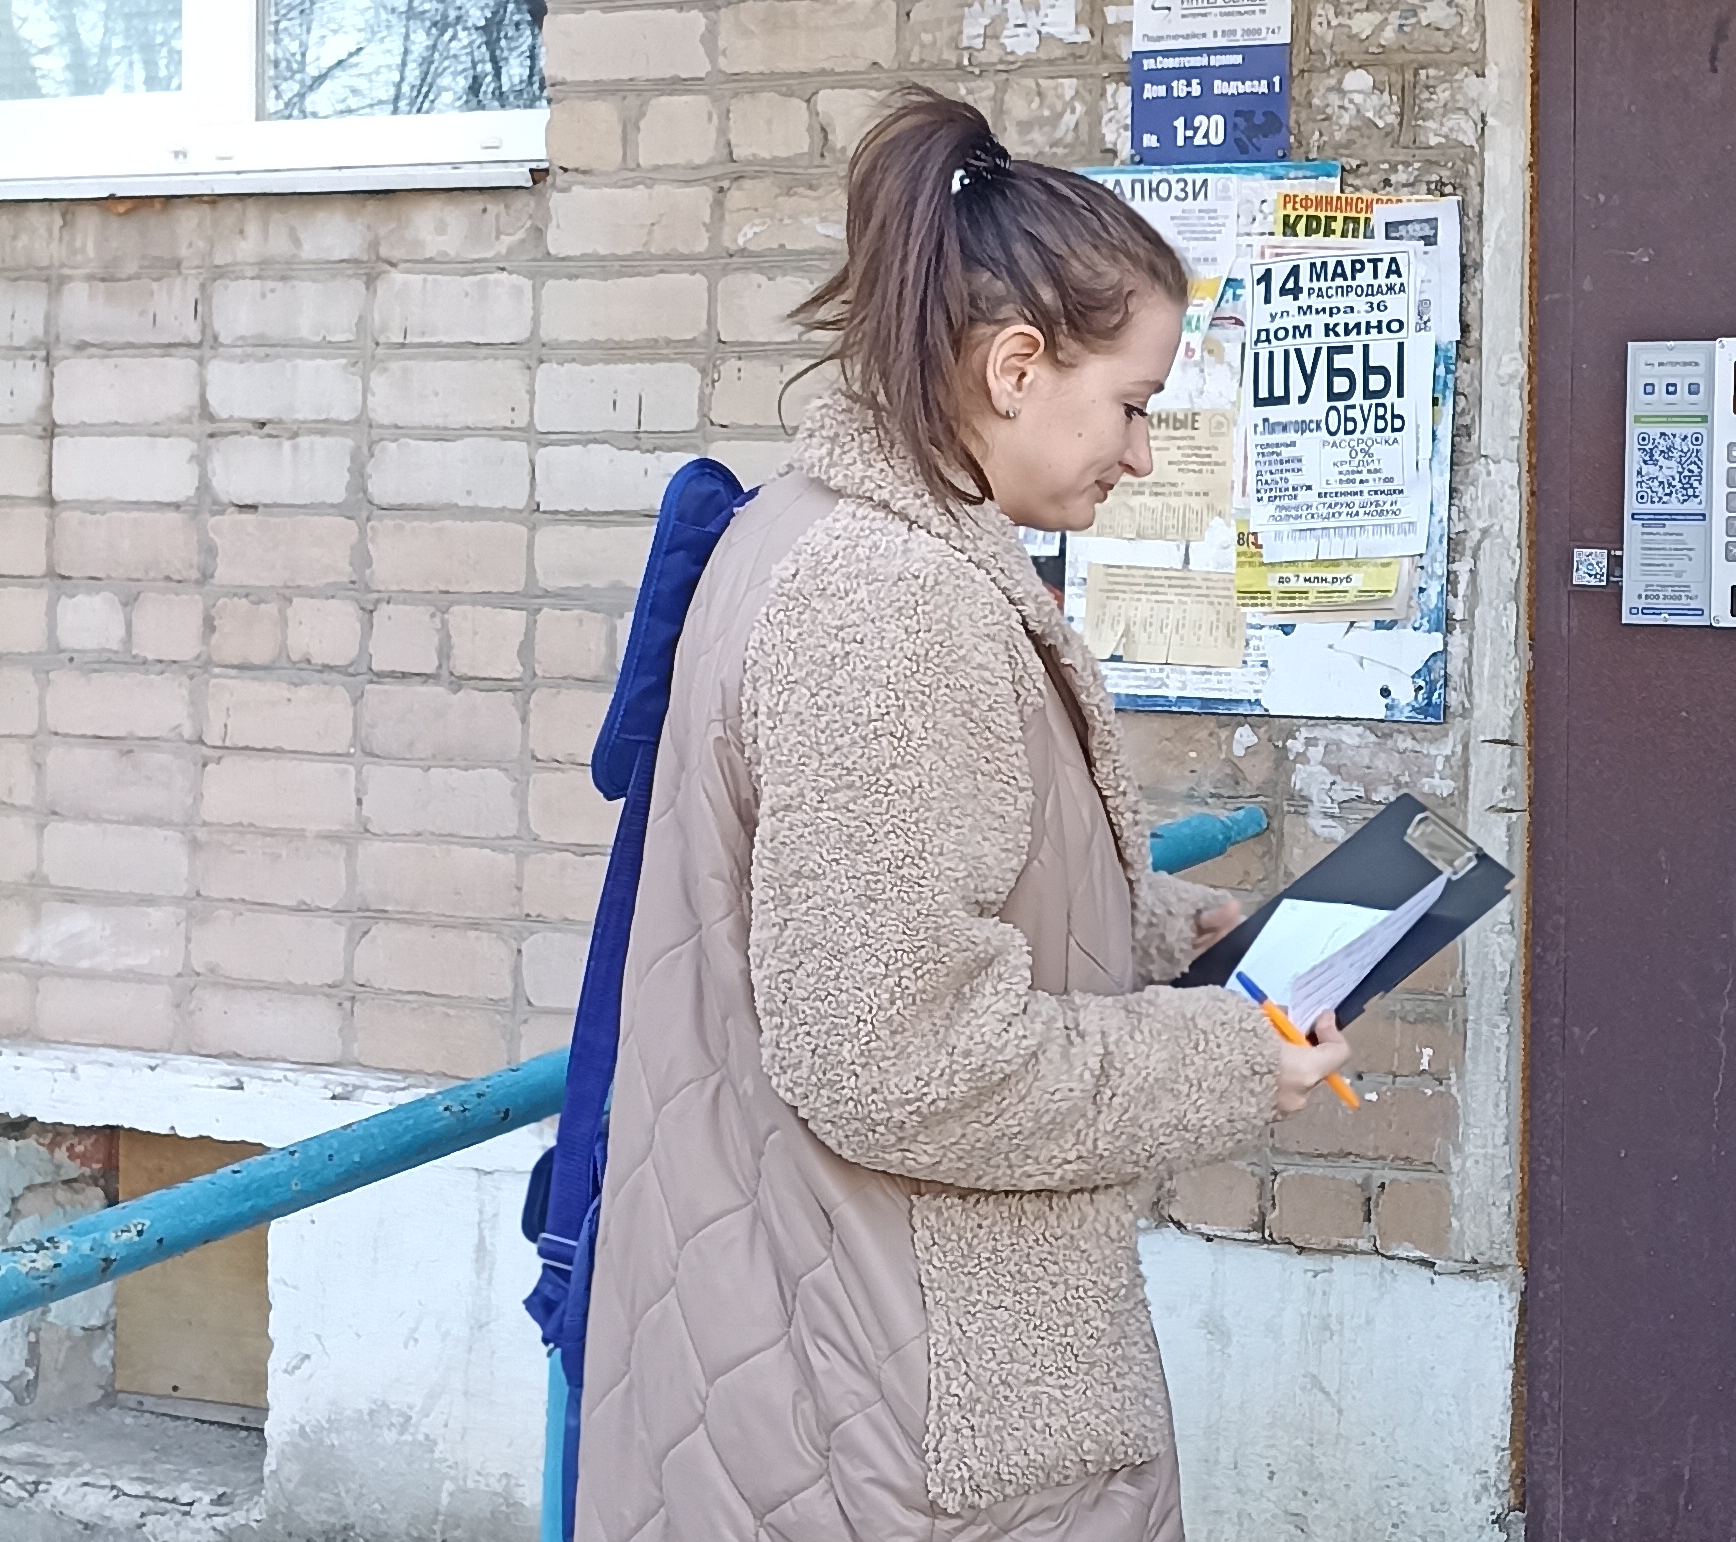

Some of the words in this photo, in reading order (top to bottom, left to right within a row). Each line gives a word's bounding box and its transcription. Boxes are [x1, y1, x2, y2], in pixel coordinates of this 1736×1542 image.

[1143, 83, 1167, 100] Дом
[1213, 79, 1269, 96] Подъезд
[1272, 75, 1280, 93] 1
[1174, 115, 1225, 147] 1-20
[1256, 264, 1304, 305] 14
[1309, 257, 1403, 283] МАРТА
[1308, 282, 1406, 299] РАСПРОДАЖА
[1253, 341, 1404, 408] ШУБЫ
[1325, 401, 1405, 436] ОБУВЬ
[1322, 437, 1400, 449] РАССРОЧКА
[1349, 447, 1374, 459] 0%
[1333, 459, 1382, 468] КРЕДИТ
[1256, 477, 1289, 486] ПАЛЬТО
[1318, 490, 1364, 499] ВЕСЕННИЕ
[1368, 489, 1404, 497] СКИДКИ
[1316, 501, 1356, 511] СТАРУЮ
[1358, 499, 1388, 509] ШУБУ
[1346, 510, 1360, 518] НА
[1363, 508, 1402, 517] НОВУЮ
[1278, 575, 1291, 585] до
[1294, 575, 1300, 583] 7
